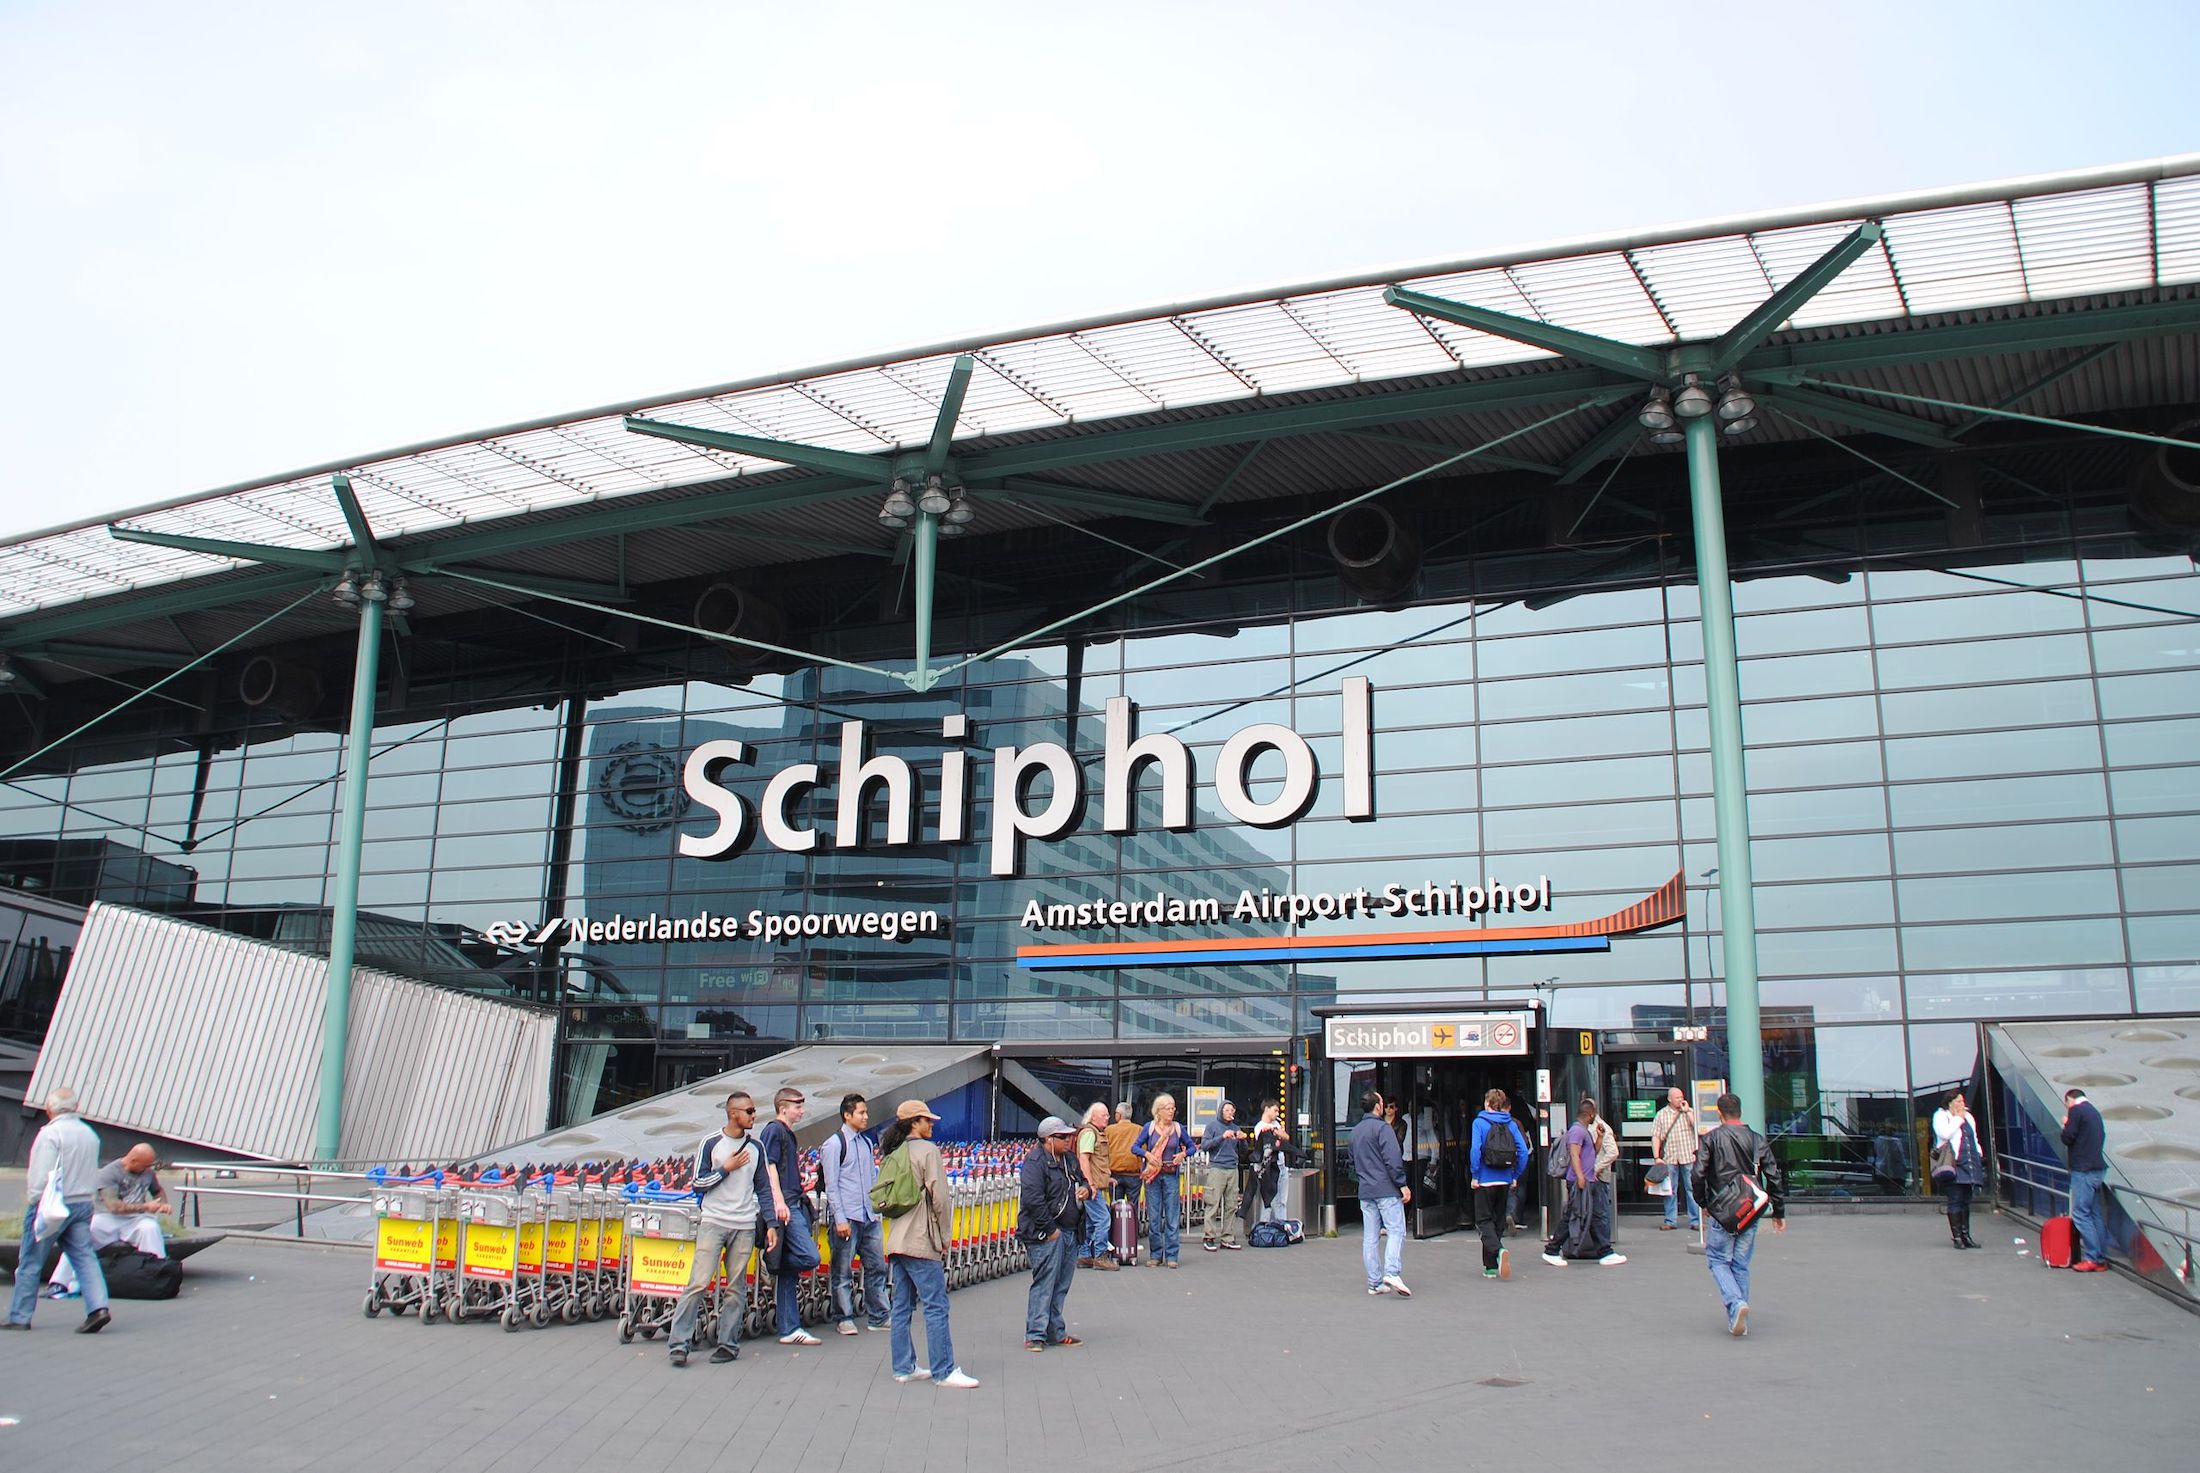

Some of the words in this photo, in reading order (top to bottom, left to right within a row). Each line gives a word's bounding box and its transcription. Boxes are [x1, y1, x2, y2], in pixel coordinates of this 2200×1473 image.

[679, 675, 1370, 876] Schiphol
[1020, 892, 1219, 928] Amsterdam
[1233, 887, 1368, 924] Airport
[1383, 874, 1549, 918] Schiphol
[570, 911, 739, 942] Nederlandse
[747, 909, 938, 943] Spoorwegen
[700, 973, 736, 988] Free
[1333, 1024, 1427, 1050] Schiphol
[1582, 1034, 1590, 1051] D
[386, 1235, 424, 1249] Sunweb
[473, 1241, 508, 1255] Sunweb
[547, 1239, 567, 1249] web
[642, 1256, 686, 1270] Sunweb
